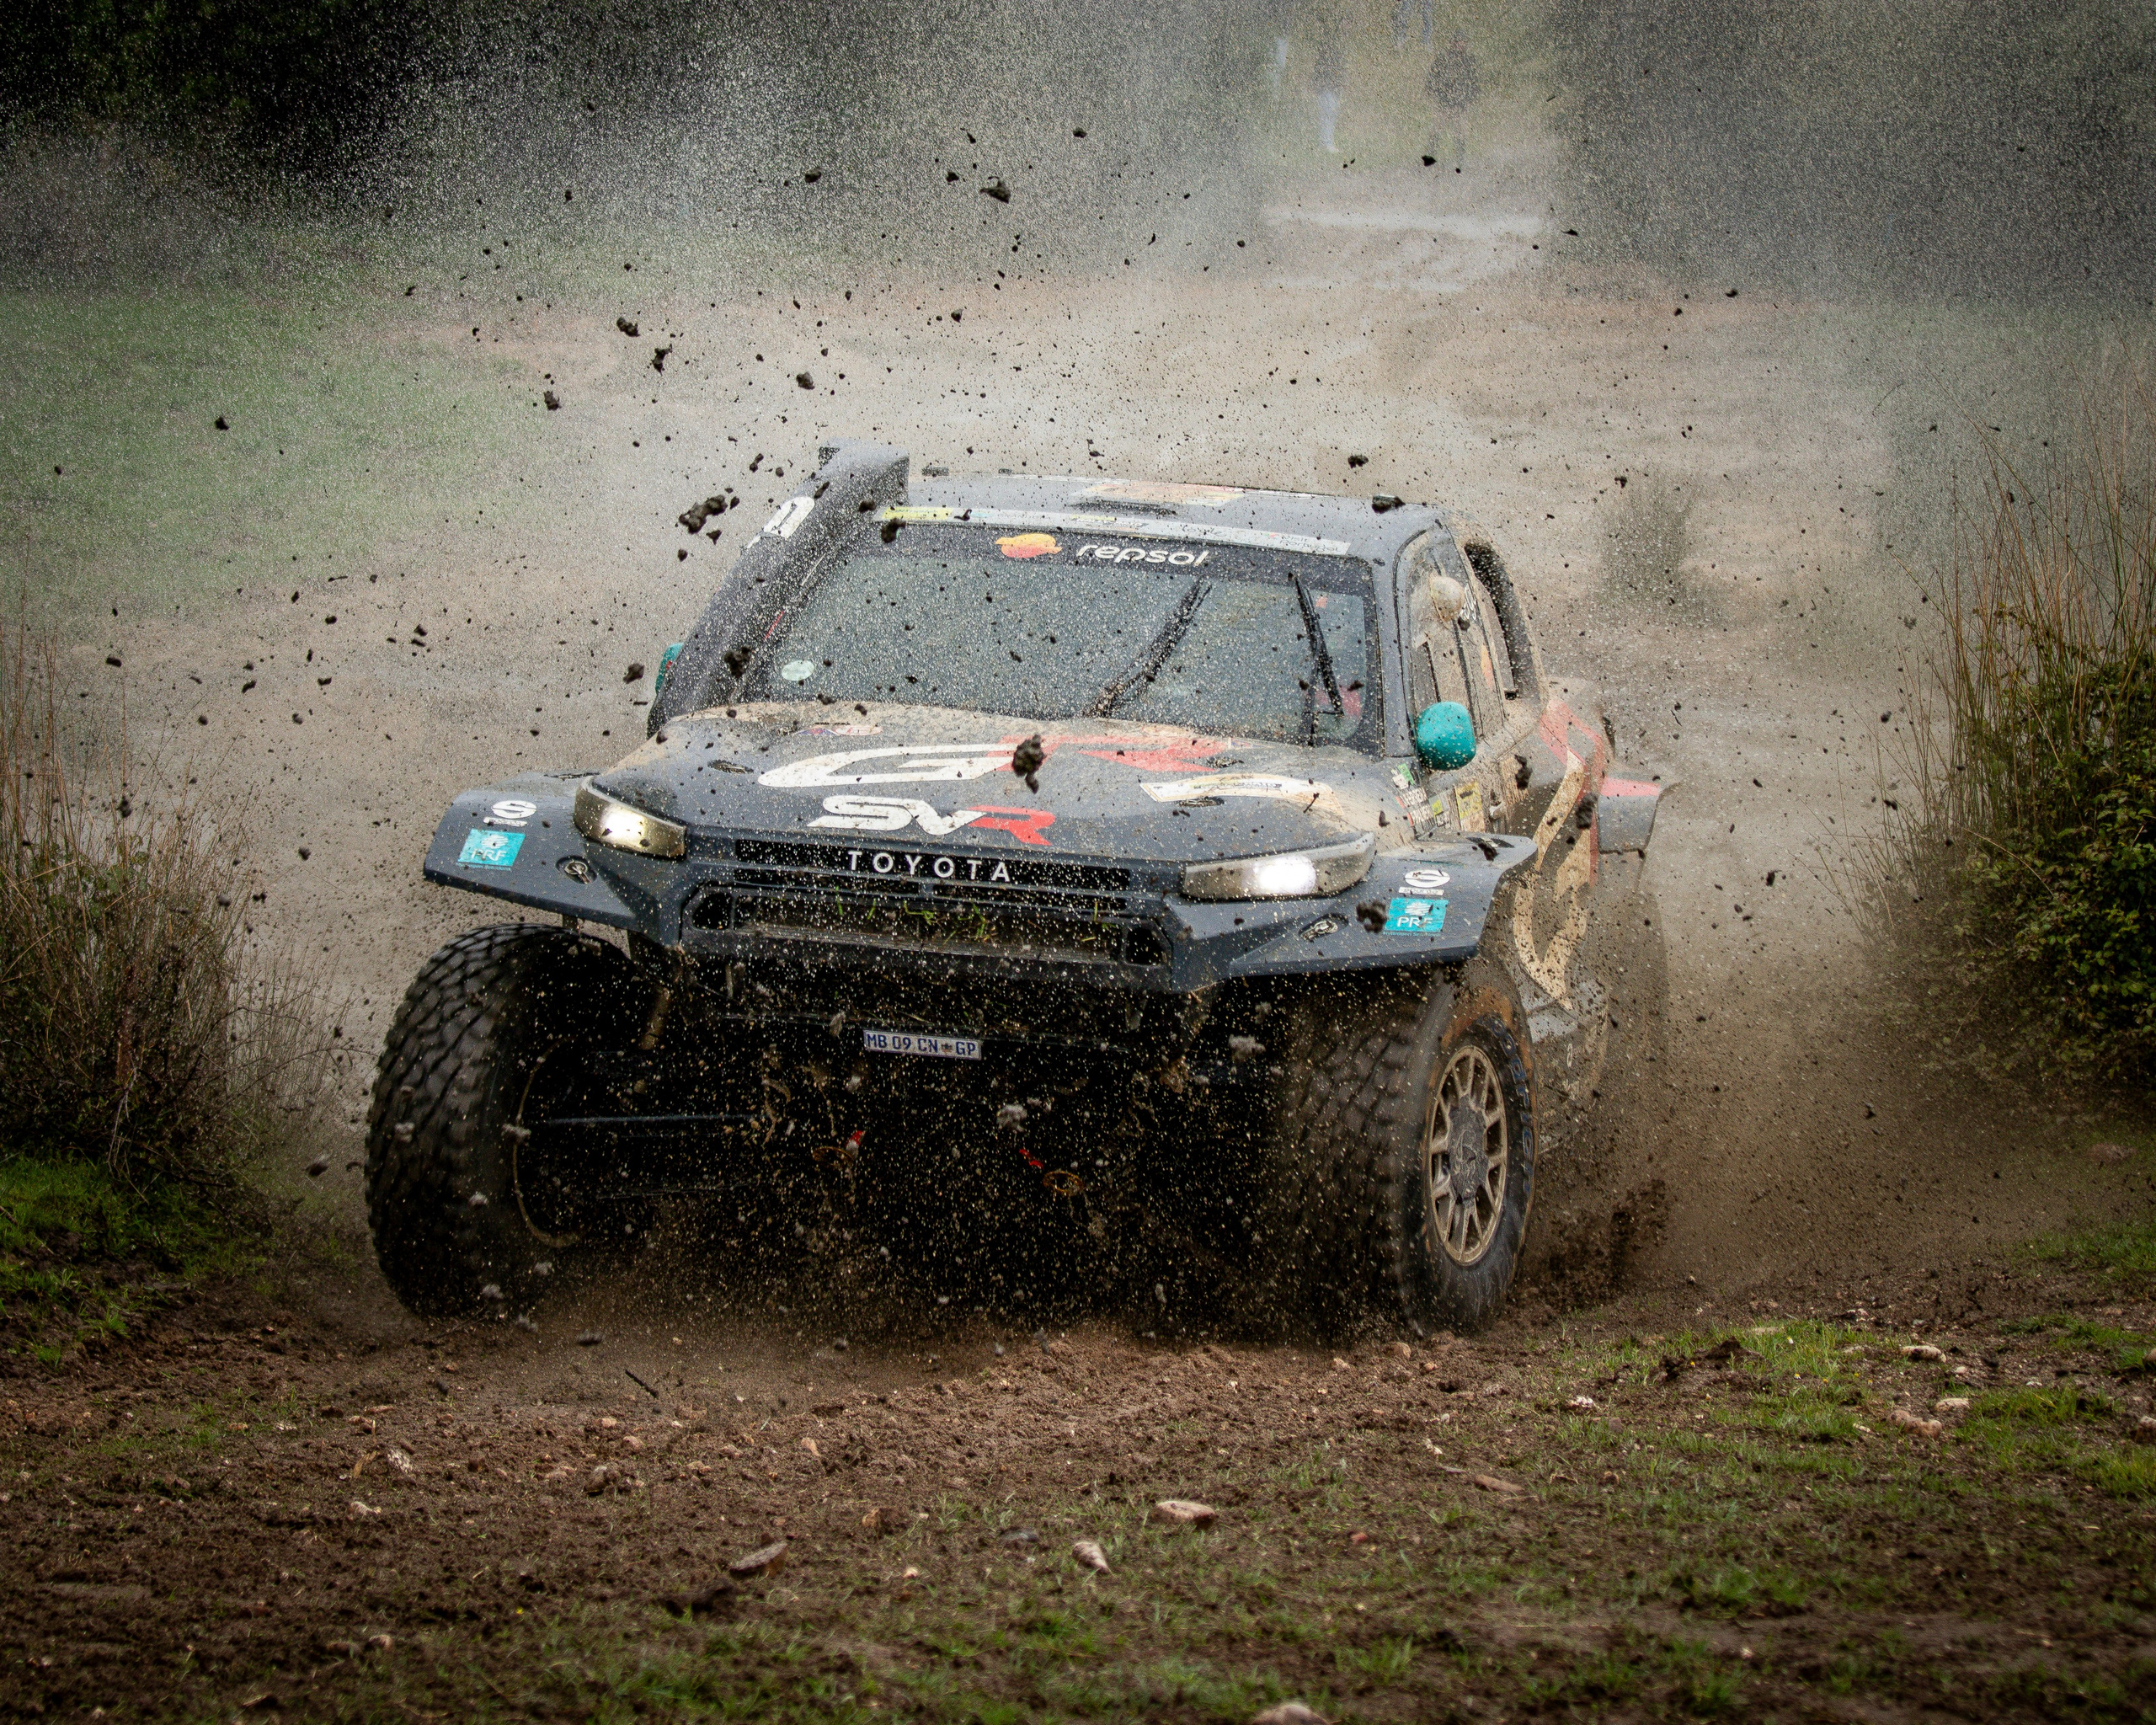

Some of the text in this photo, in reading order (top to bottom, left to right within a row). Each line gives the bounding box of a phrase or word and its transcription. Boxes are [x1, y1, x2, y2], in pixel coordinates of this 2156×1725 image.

[1075, 544, 1210, 568] repsol
[472, 848, 507, 862] PRF
[847, 850, 1011, 883] TOYOTA
[867, 1033, 976, 1055] MB 09 CN GP
